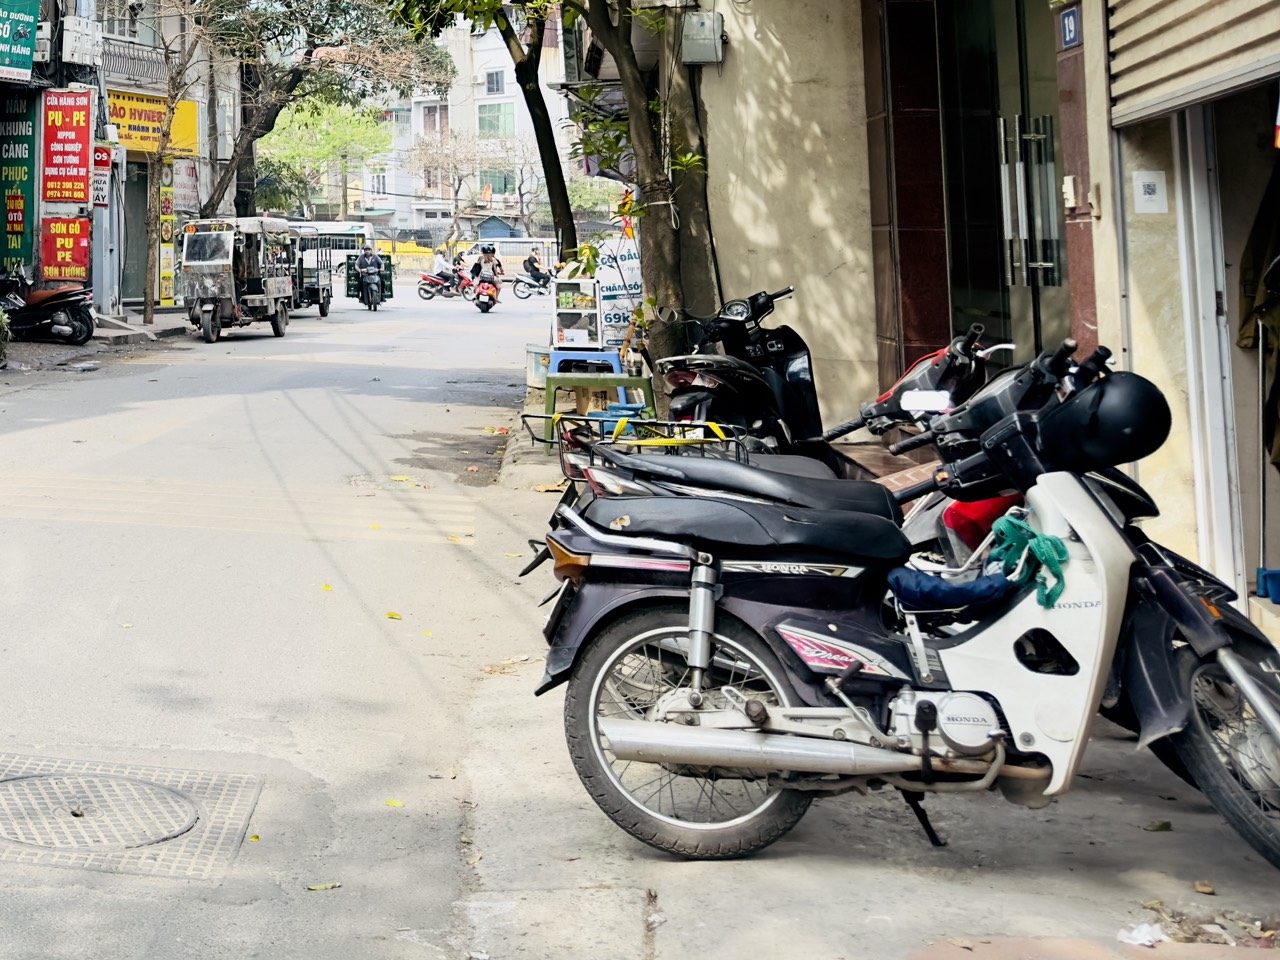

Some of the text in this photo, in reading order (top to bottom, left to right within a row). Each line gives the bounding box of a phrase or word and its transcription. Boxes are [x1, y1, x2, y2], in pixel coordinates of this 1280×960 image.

[1064, 15, 1075, 41] 19
[47, 110, 63, 127] PU
[72, 111, 86, 127] PE
[0, 120, 32, 136] KHUNG
[2, 141, 28, 159] CÀNG
[1, 166, 28, 185] PHỤC
[94, 193, 107, 202] ÁY
[56, 237, 74, 248] PU
[57, 251, 72, 262] PE
[760, 564, 809, 572] HONDA
[808, 648, 854, 663] Drea
[946, 715, 988, 724] HONDA
